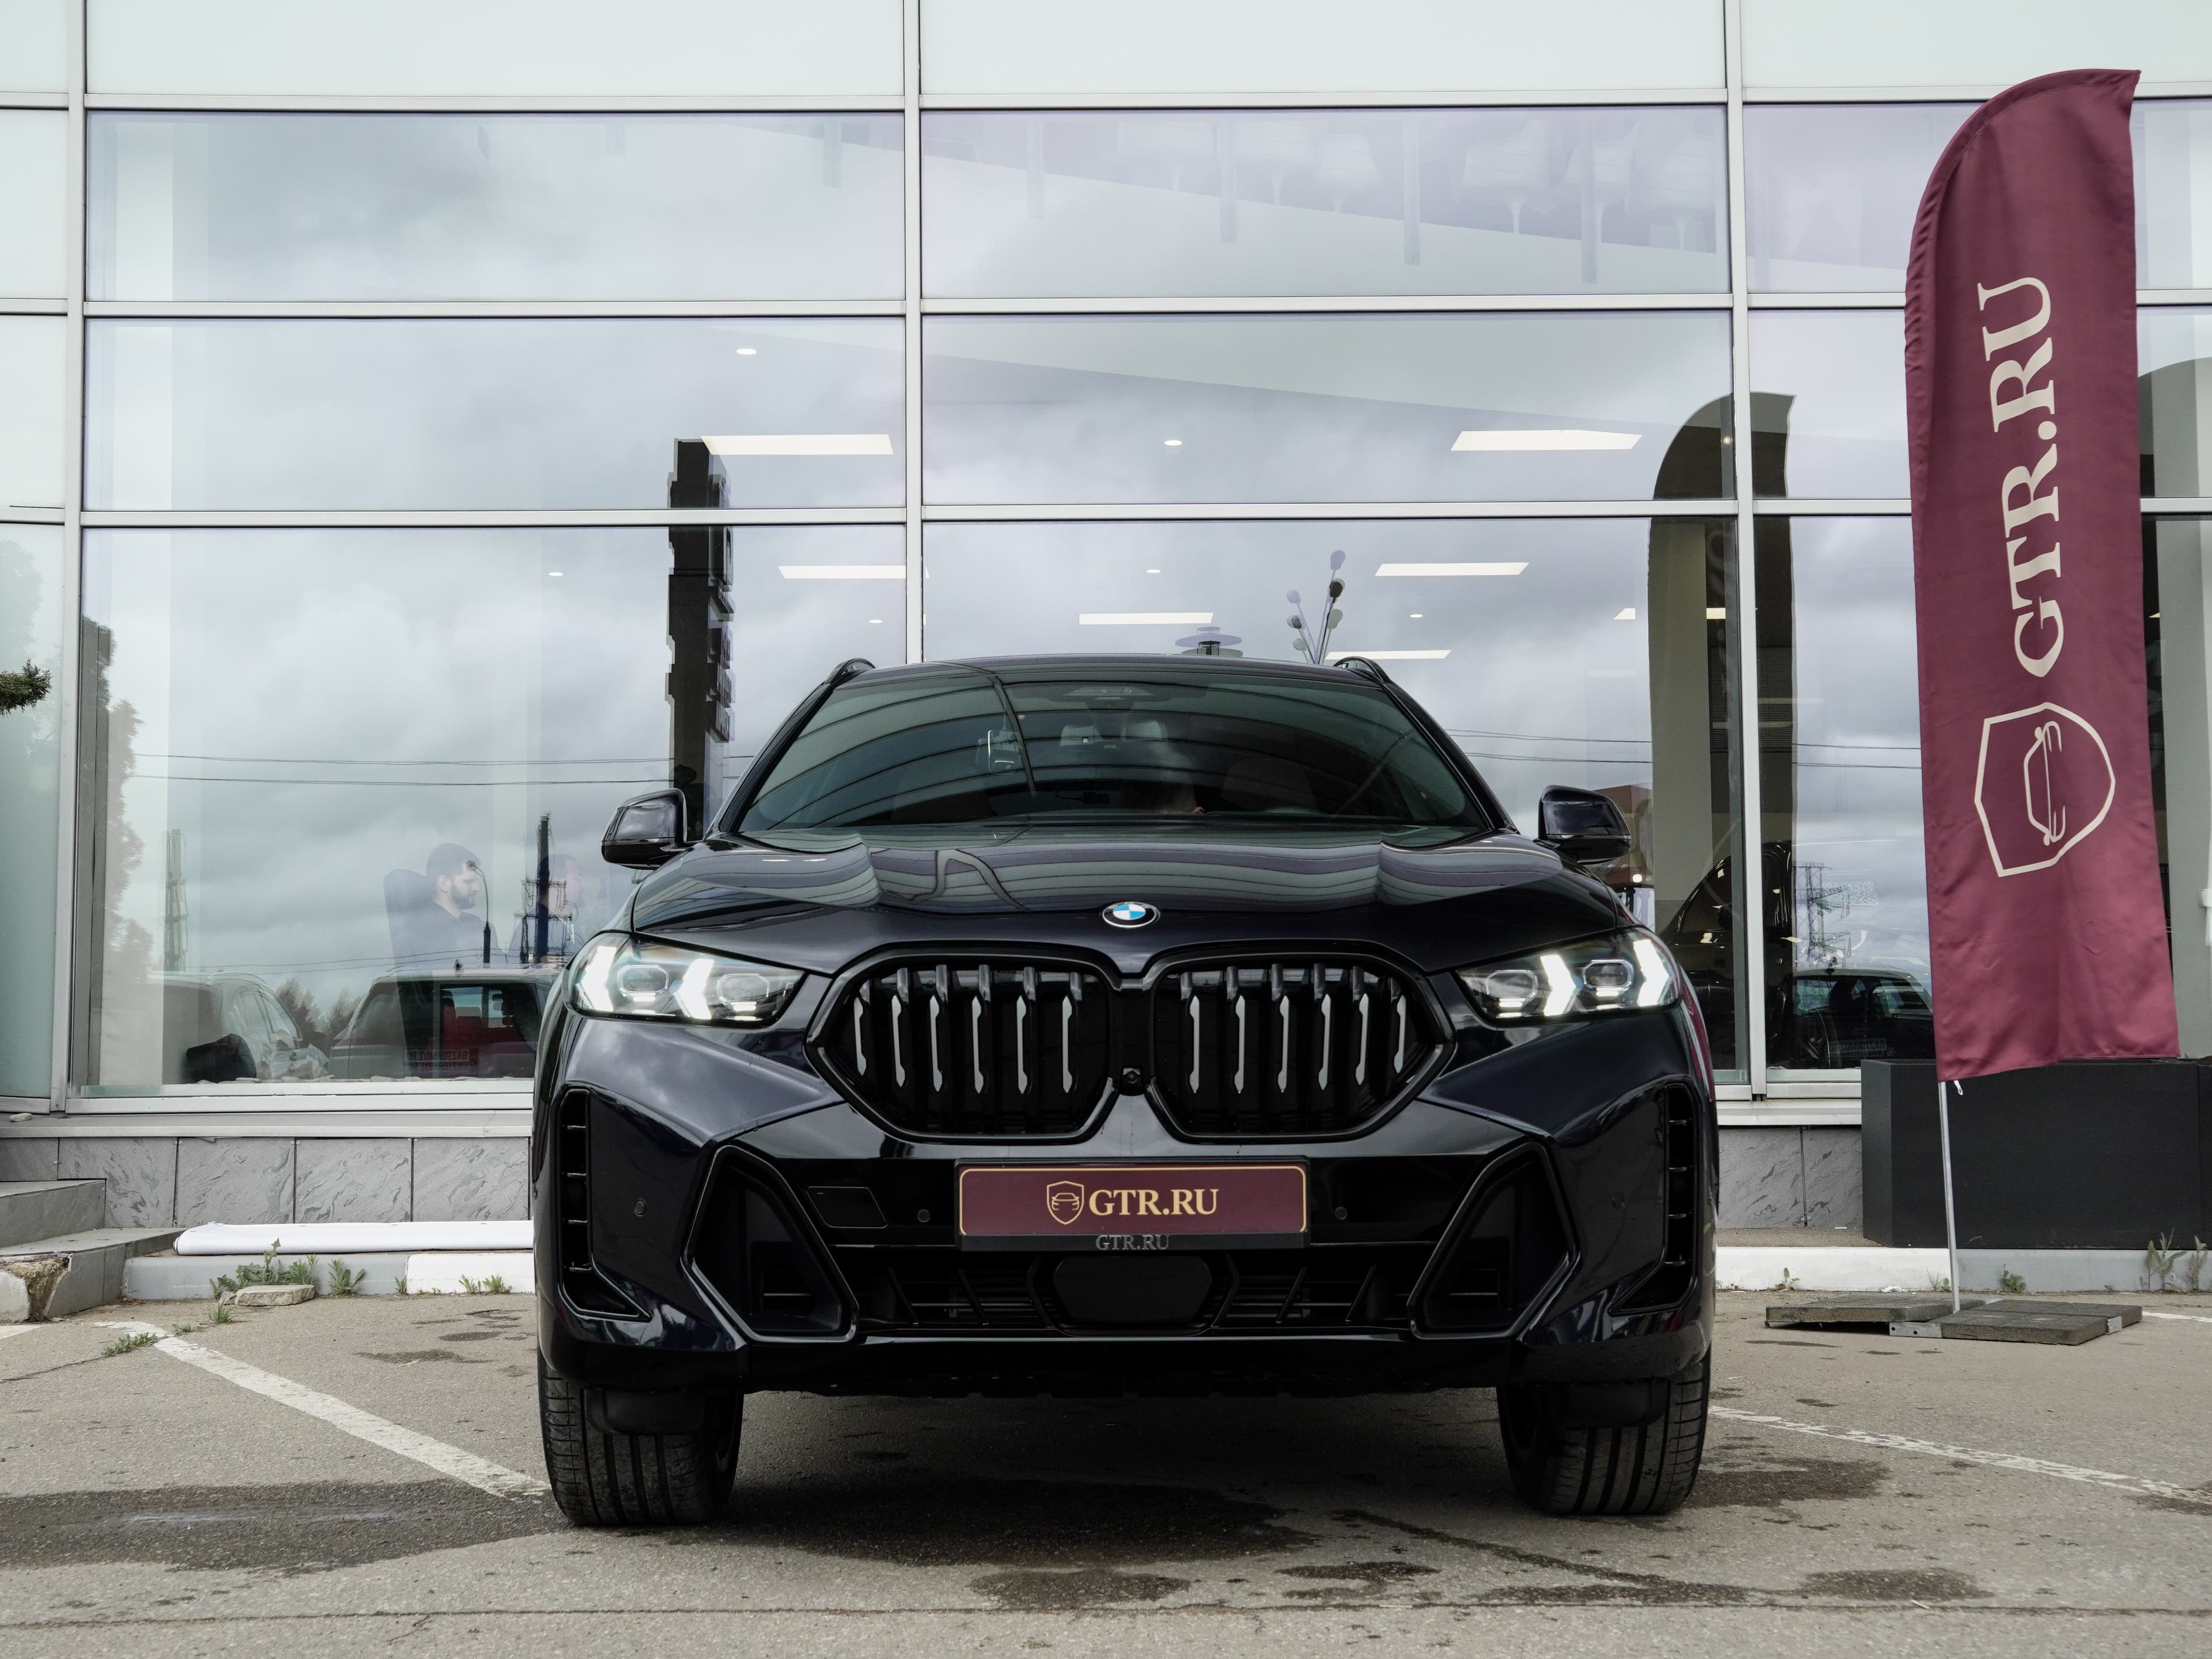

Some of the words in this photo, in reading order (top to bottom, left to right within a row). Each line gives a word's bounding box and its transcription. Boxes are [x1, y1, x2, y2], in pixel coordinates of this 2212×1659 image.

[1977, 276, 2064, 678] GTR.RU
[1089, 1189, 1219, 1216] GTR.RU
[1095, 1234, 1170, 1250] GTR.RU
